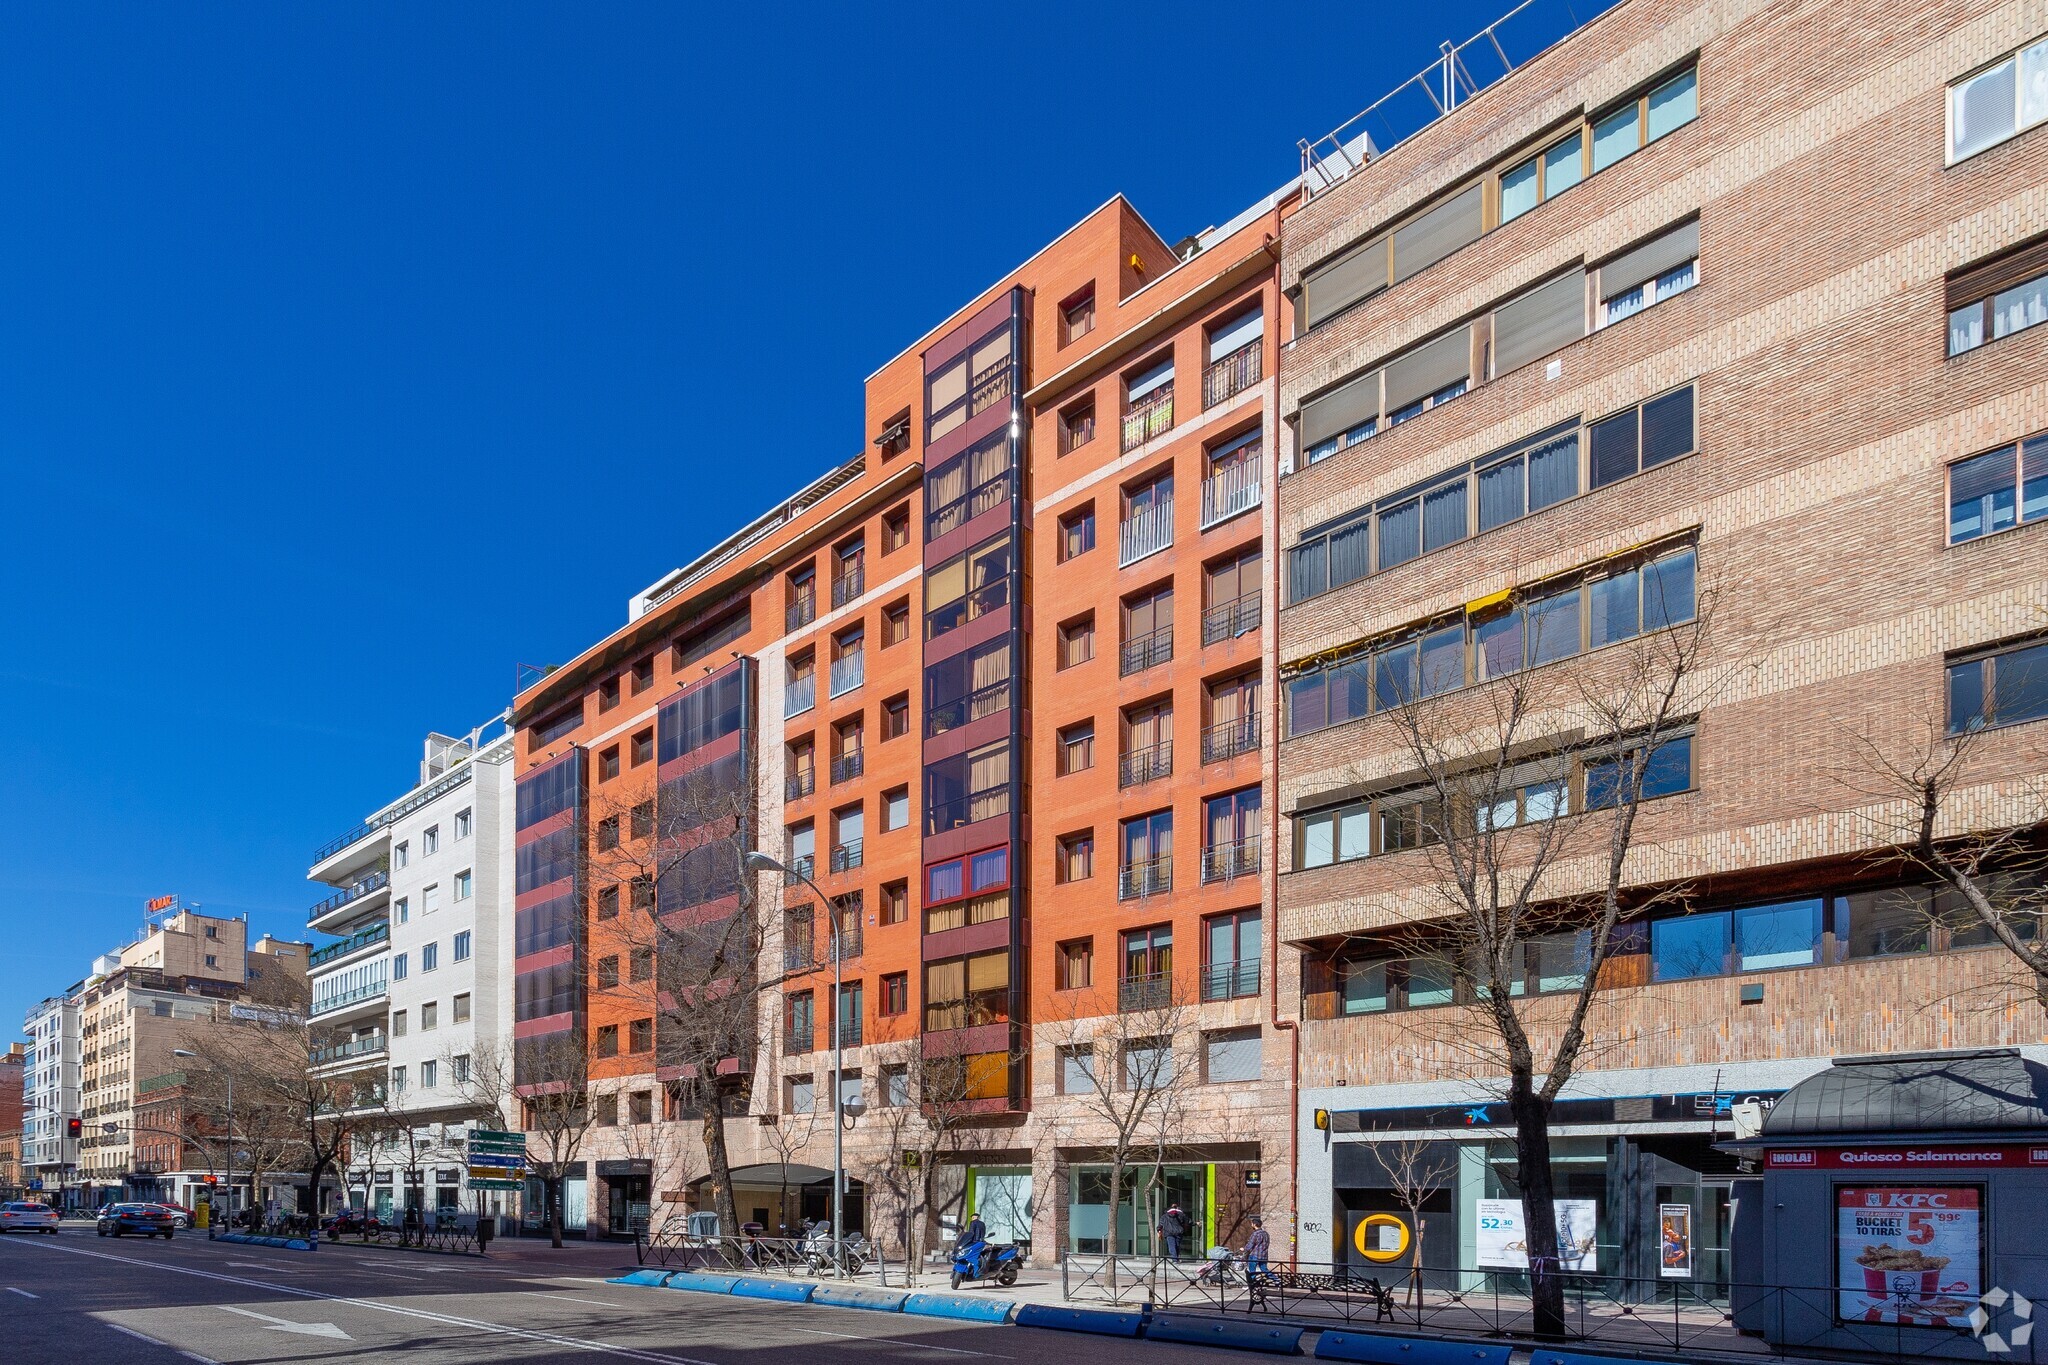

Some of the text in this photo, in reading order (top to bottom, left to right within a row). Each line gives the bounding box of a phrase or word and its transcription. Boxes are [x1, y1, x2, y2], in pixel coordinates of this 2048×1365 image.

[1839, 1151, 2002, 1162] Quiosco Salamanca
[1886, 1193, 1949, 1208] KFC
[1856, 1217, 1902, 1227] BUCKET
[1856, 1227, 1902, 1236] 10 TIRAS
